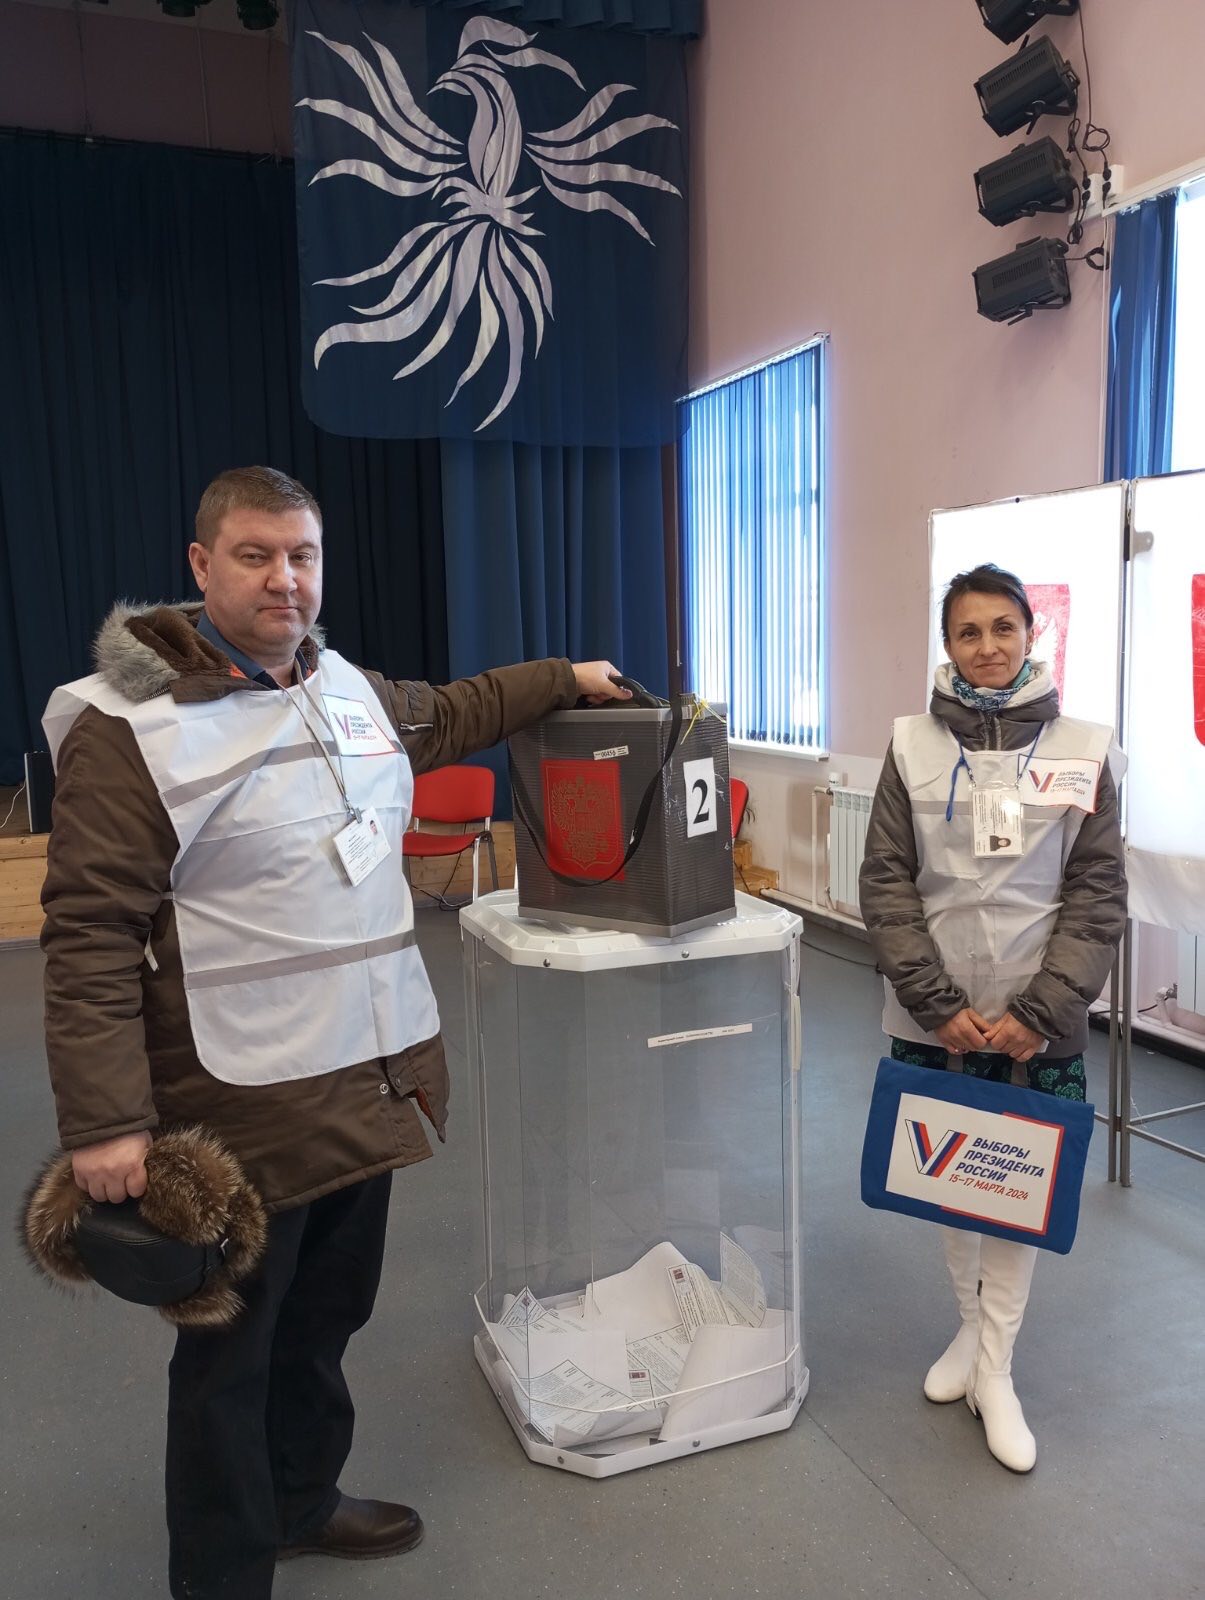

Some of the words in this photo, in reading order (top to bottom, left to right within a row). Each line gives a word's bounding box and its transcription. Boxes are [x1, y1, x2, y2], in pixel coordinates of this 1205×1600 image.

[691, 778, 710, 825] 2
[972, 1137, 1031, 1159] ВЫБОРЫ
[955, 1162, 1008, 1182] РОССИИ
[963, 1149, 1045, 1178] ПРЕЗИДЕНТА
[973, 1180, 1007, 1195] МАРТА
[1005, 1188, 1029, 1200] 2024
